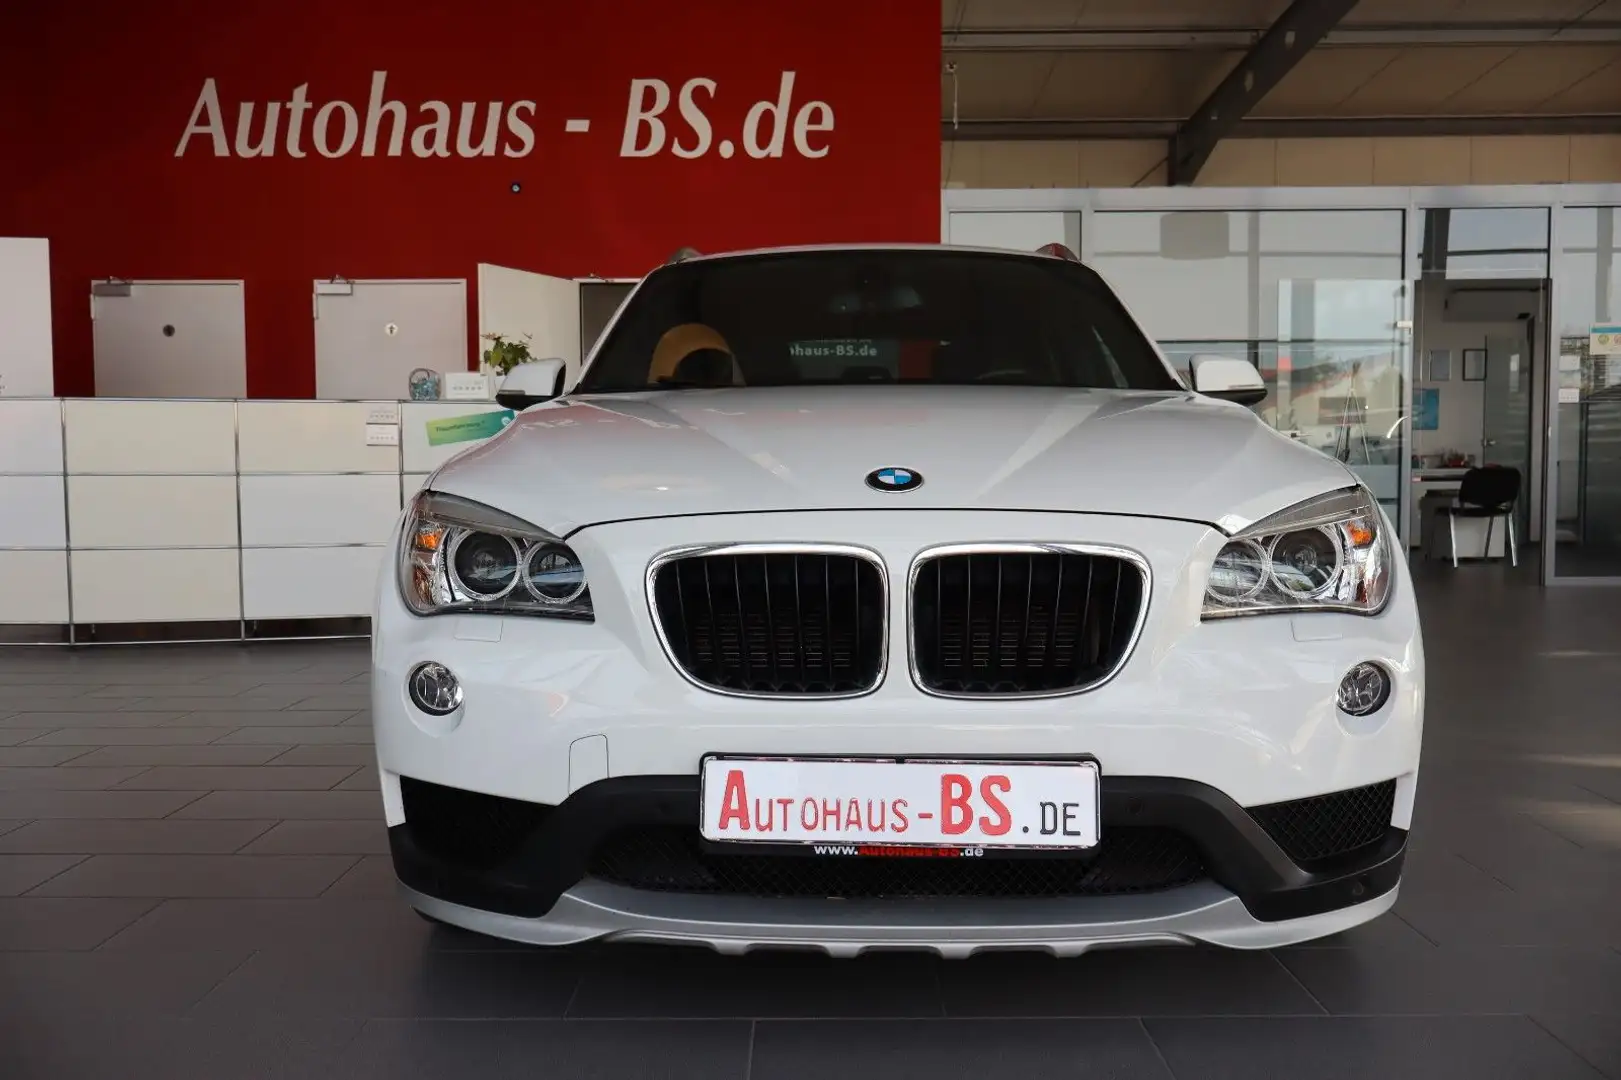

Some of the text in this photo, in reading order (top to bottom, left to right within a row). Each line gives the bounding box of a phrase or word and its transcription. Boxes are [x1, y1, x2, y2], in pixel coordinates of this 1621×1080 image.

[175, 71, 834, 158] Autohaus - BS.de
